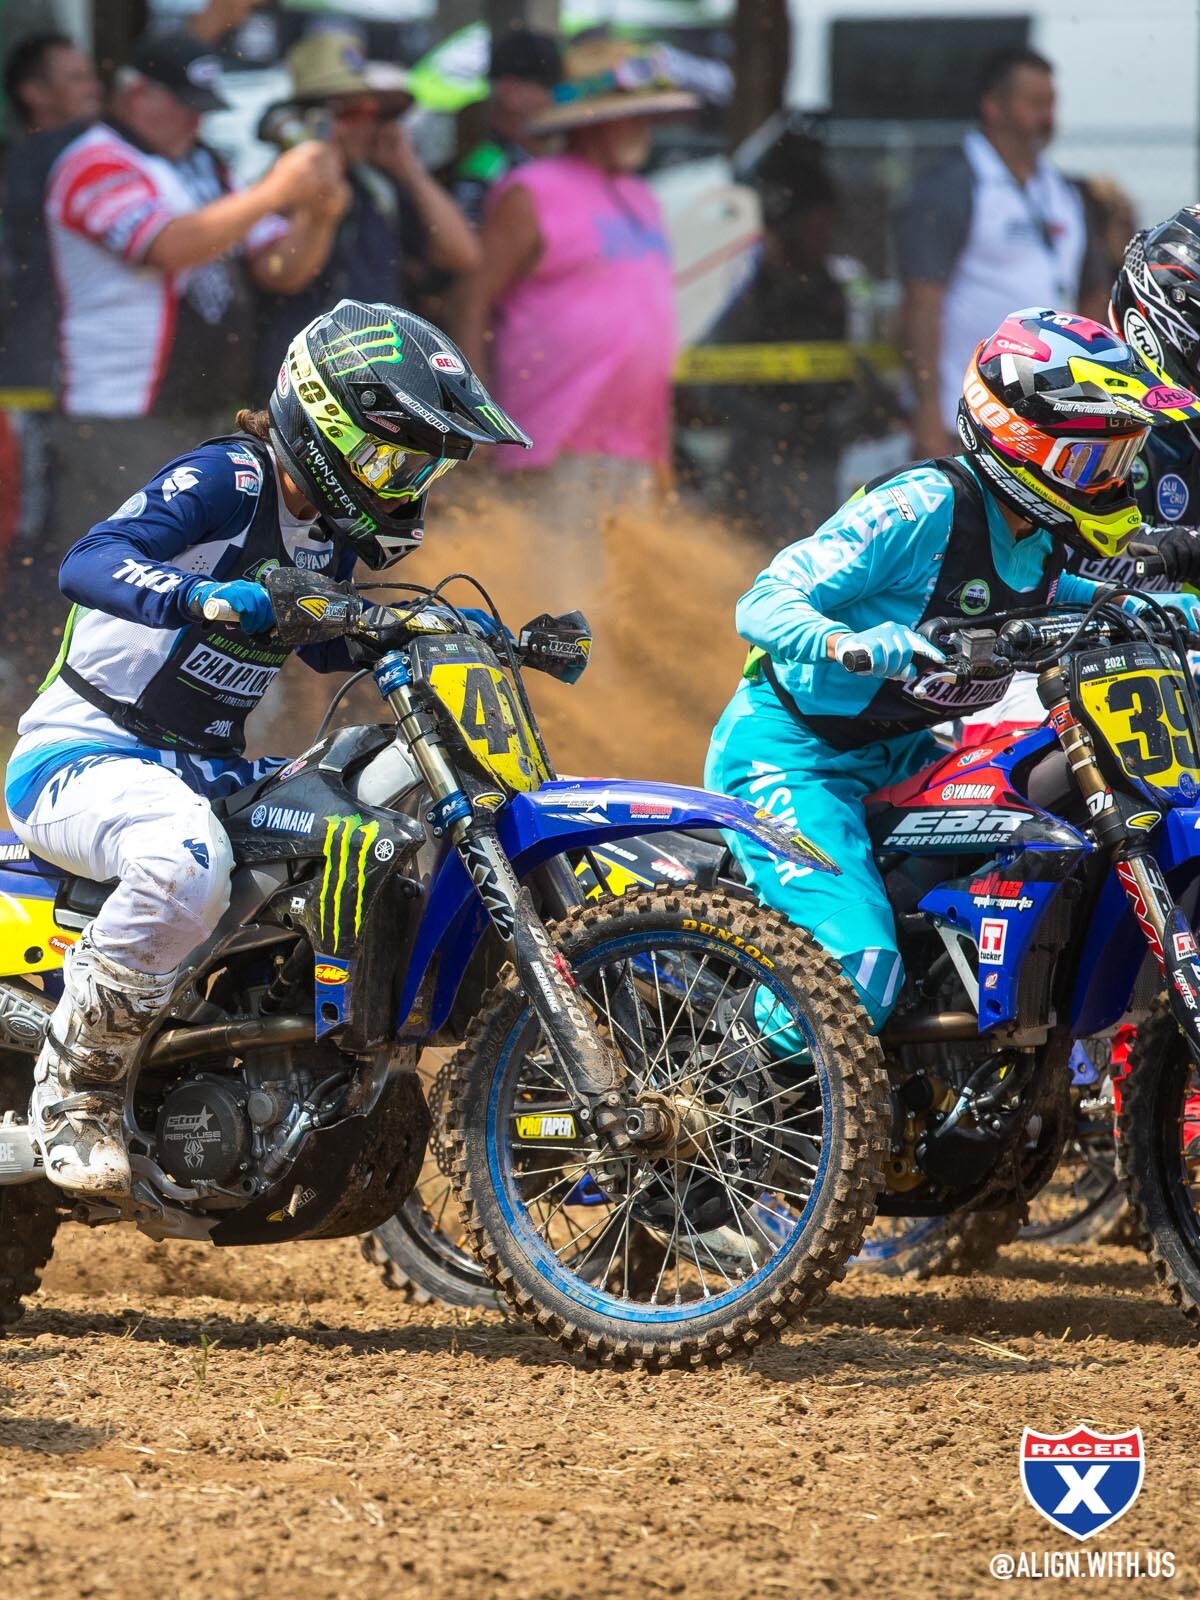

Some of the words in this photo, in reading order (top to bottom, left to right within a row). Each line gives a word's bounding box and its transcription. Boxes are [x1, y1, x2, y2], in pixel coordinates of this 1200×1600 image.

[435, 357, 458, 368] BELL
[1072, 403, 1117, 414] Performance
[306, 457, 341, 509] ENERGY
[307, 440, 357, 516] MONSTER
[1104, 655, 1127, 670] 2021
[1108, 676, 1199, 777] 39
[953, 784, 996, 800] YAMAHA
[266, 807, 316, 834] YAMAHA
[891, 810, 1035, 834] EBR
[883, 834, 1012, 846] PERFORMANCE
[681, 919, 775, 970] DUNLOP
[980, 951, 1002, 962] tucker
[315, 967, 350, 981] FMF
[529, 961, 561, 1014] BRAKING
[1172, 969, 1198, 1009] VERTEX
[164, 1131, 222, 1140] REKLUSE
